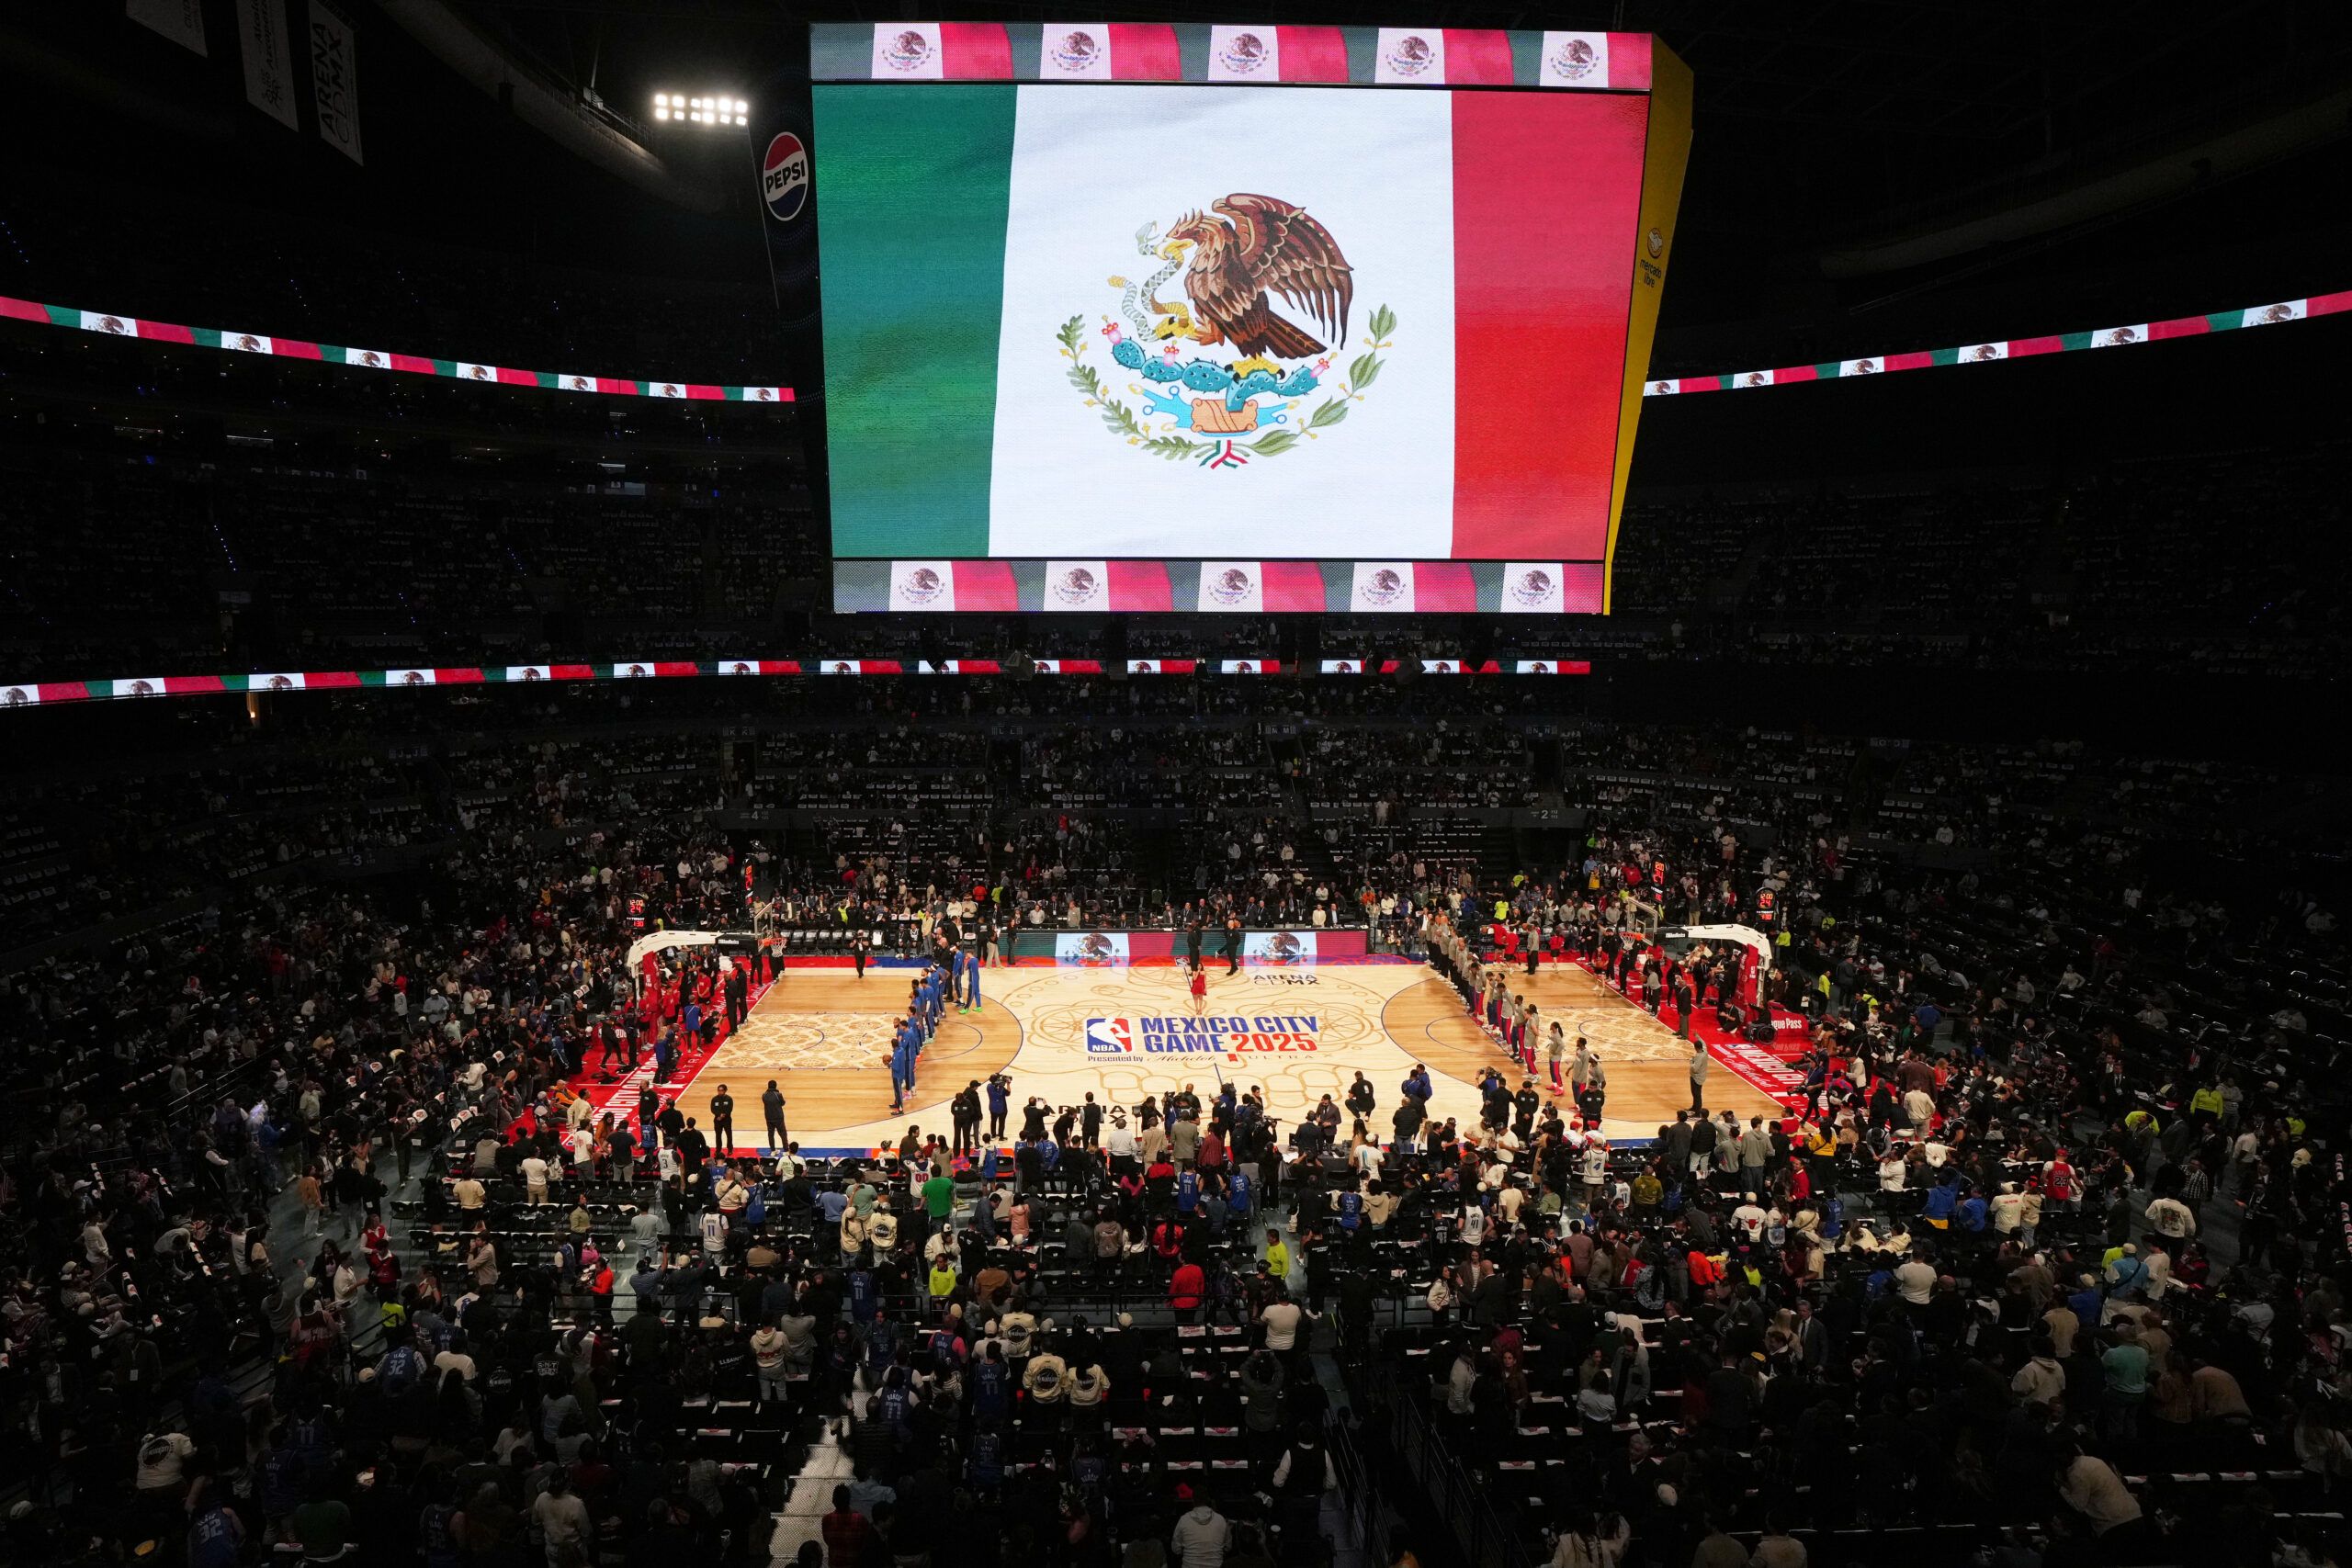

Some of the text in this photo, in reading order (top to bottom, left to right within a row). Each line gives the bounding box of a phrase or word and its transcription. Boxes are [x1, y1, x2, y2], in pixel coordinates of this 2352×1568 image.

[312, 22, 335, 135] ARENA
[326, 28, 349, 143] CDMX
[765, 160, 806, 194] PEPSI
[1640, 259, 1661, 278] mercado
[630, 905, 642, 913] 24
[1140, 1016, 1319, 1034] MEXICO CITY
[1785, 1018, 1802, 1029] Pass
[1144, 1033, 1317, 1053] GAME 2025
[662, 1158, 668, 1168] 3
[1593, 1162, 1601, 1170] 4
[915, 1173, 929, 1183] 00
[707, 1224, 715, 1236] 11
[855, 1287, 863, 1300] 11
[388, 1359, 406, 1376] 32
[885, 1402, 902, 1419] 77
[199, 1518, 223, 1543] 32
